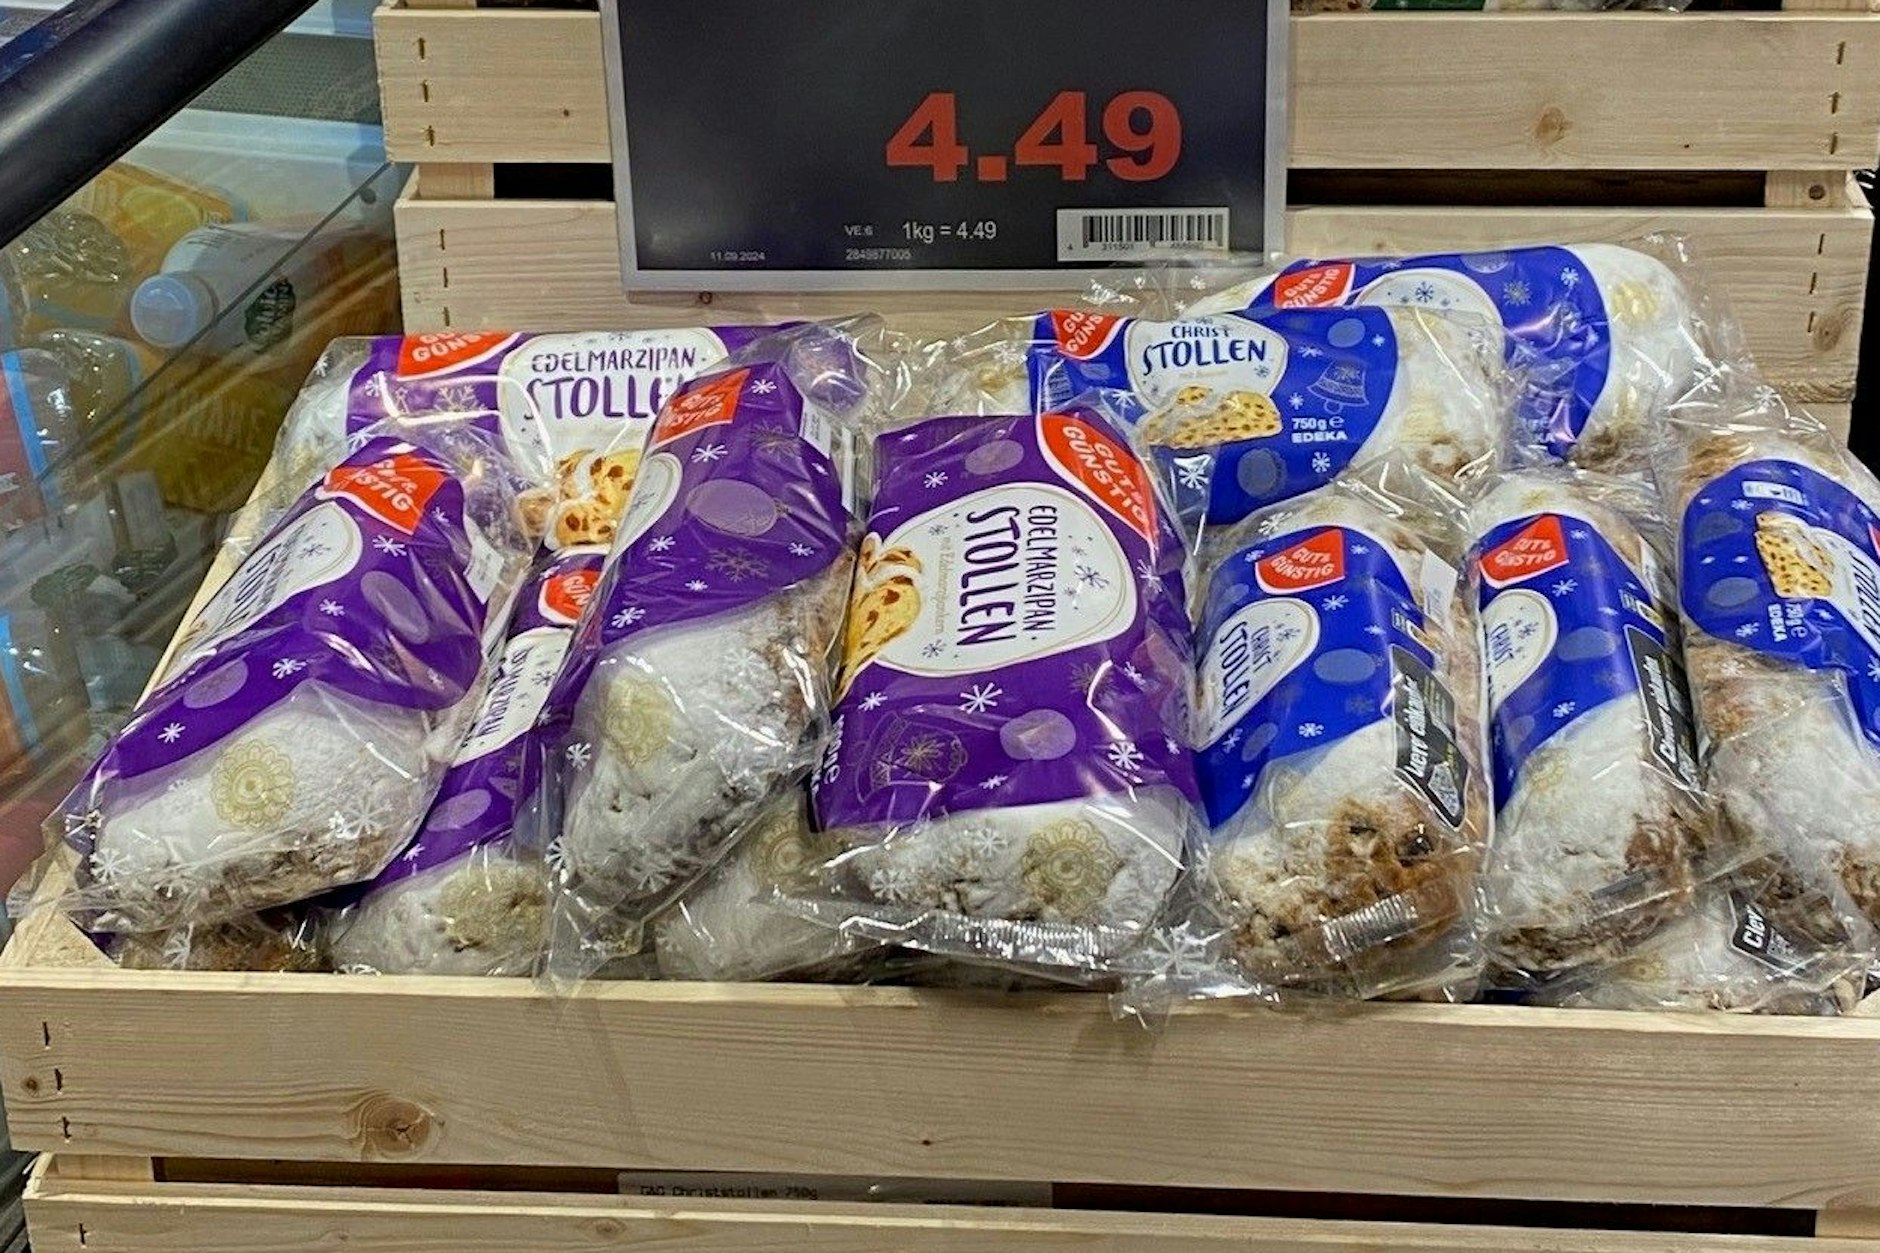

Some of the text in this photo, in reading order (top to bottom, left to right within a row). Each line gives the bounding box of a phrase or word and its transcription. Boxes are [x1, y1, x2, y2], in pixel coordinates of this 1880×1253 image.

[885, 91, 1183, 182] 4.49
[902, 221, 934, 243] 1kg
[956, 222, 997, 240] 4.49
[531, 348, 696, 373] EDELMARZIPAN
[1142, 339, 1266, 376] STOLLEN
[1171, 325, 1231, 338] CHRIST
[1291, 431, 1348, 443] EDEKA
[1062, 426, 1149, 527] GÜNSTIG
[957, 506, 1021, 646] STOLLEN
[1022, 505, 1057, 631] EDELMARZIPAN
[1220, 621, 1250, 720] STOLLEN
